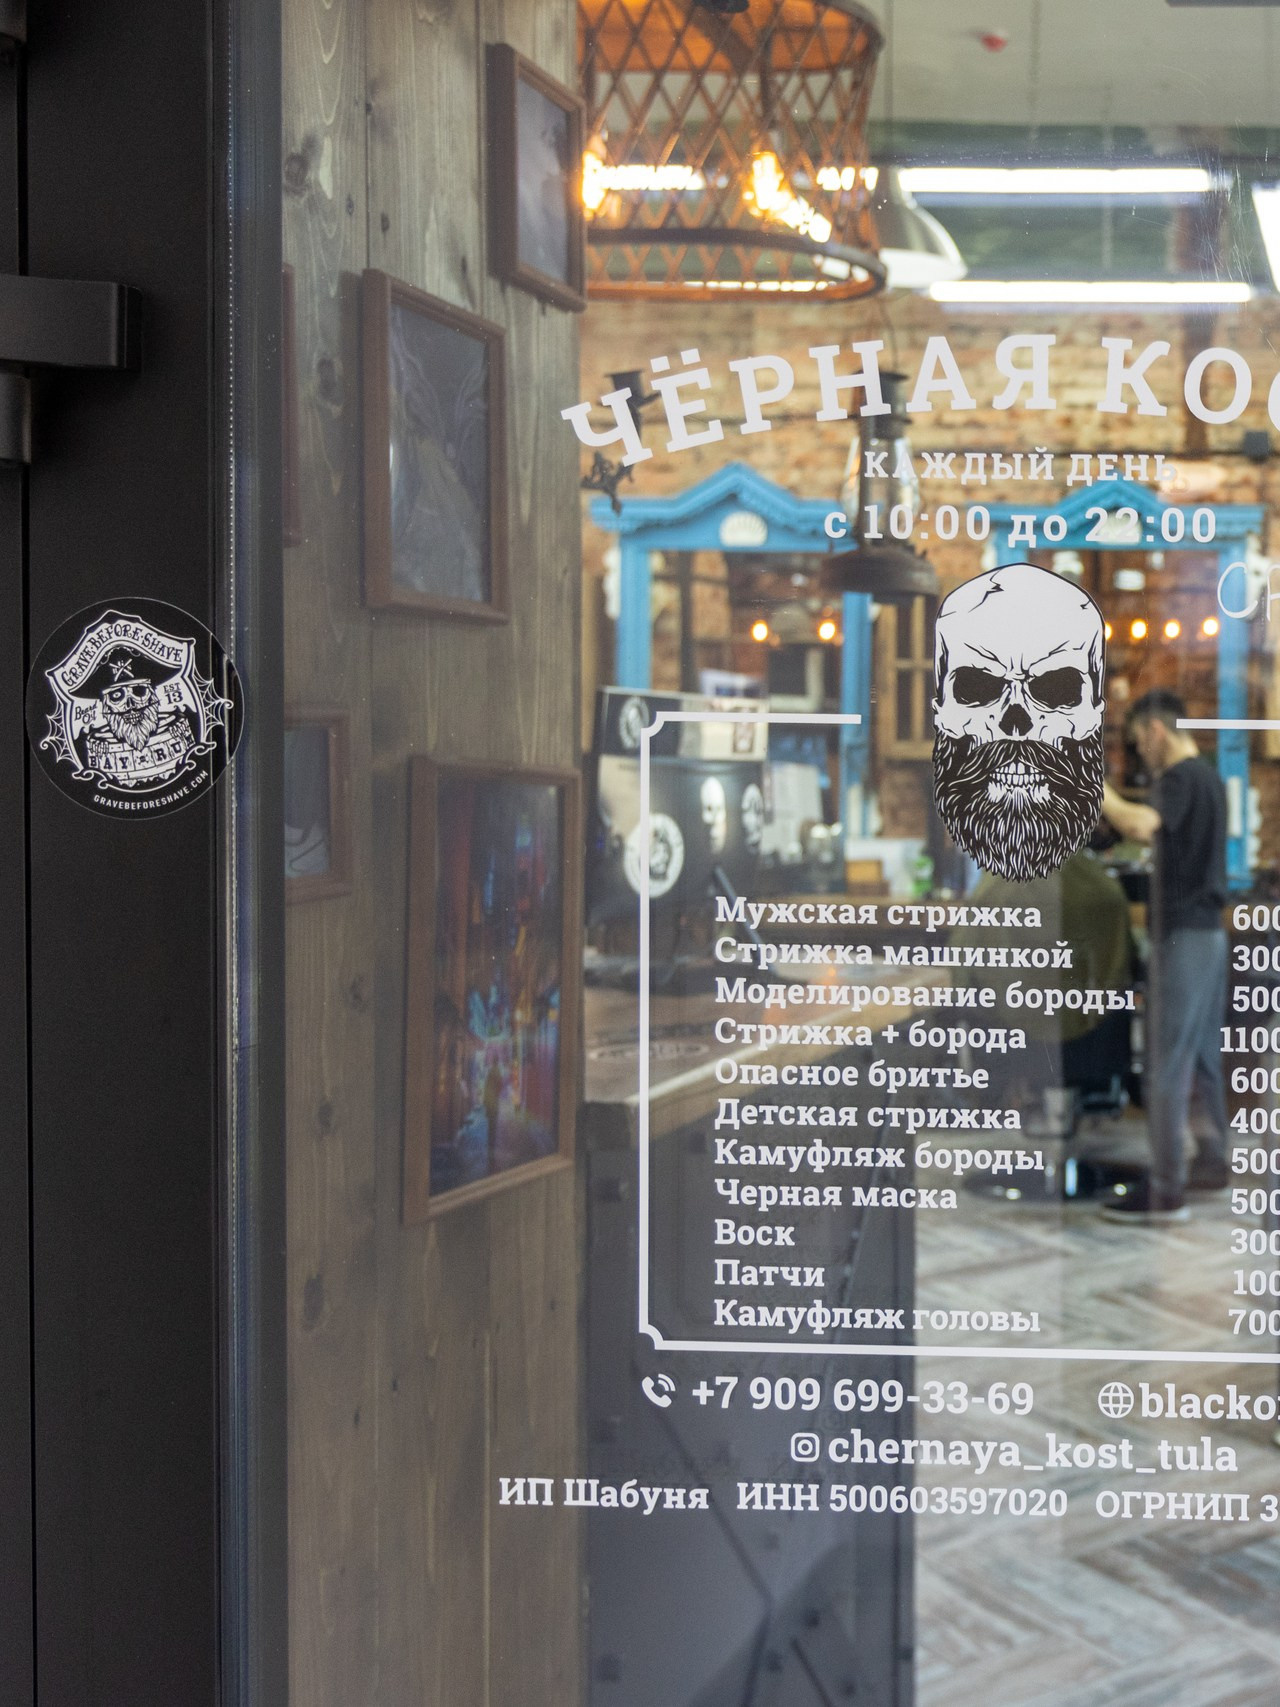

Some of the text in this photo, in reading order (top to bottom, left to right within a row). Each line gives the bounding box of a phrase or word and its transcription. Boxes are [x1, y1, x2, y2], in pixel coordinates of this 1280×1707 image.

[560, 334, 1056, 467] ЧЁРНАЯ
[865, 447, 1176, 487] КАЖДЫЙ ДЕНЬ
[823, 505, 1217, 549] с 10:00 до 22:00
[61, 623, 184, 687] GRAVE BEFORE SHAVE
[163, 683, 182, 694] EST
[165, 692, 184, 705] 13
[89, 756, 129, 770] BAY
[93, 770, 209, 811] GRAVEBEFORESHAVE.COM
[716, 897, 1041, 931] Мужская стрижка
[715, 937, 1072, 968] Стрижка машинкой
[715, 977, 1135, 1014] Моделирование бороды
[715, 1017, 1026, 1053] Стрижка + борода
[714, 1058, 988, 1093] Опасное бритье
[715, 1099, 1021, 1133] Детская стрижка
[715, 1139, 1044, 1174] Камуфляж бороды
[715, 1179, 957, 1211] Черная маска
[715, 1219, 795, 1245] Воск
[715, 1259, 824, 1286] Патчи
[714, 1299, 1041, 1335] Камуфляж головы
[693, 1377, 1033, 1416] +7 909 699-33-69
[828, 1429, 1238, 1474] chernaya_kost_tula
[500, 1478, 553, 1505] ИП
[564, 1479, 708, 1514] Шабуня
[737, 1483, 819, 1510] ИНН
[830, 1483, 1067, 1518] 500603597020
[1096, 1490, 1250, 1521] ОГРНИП
